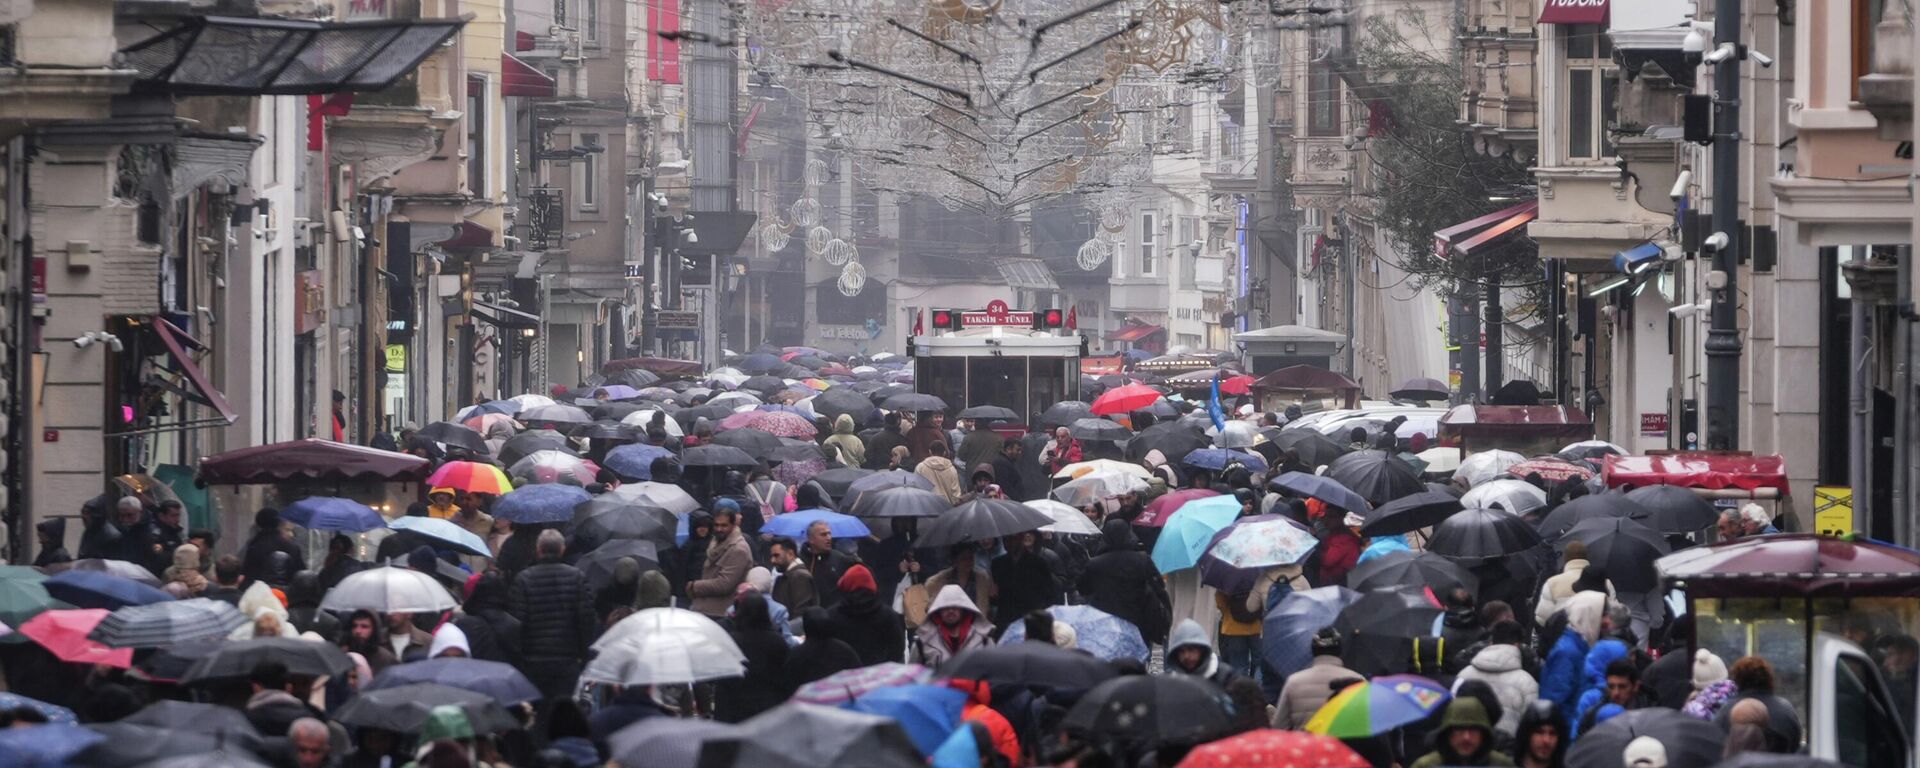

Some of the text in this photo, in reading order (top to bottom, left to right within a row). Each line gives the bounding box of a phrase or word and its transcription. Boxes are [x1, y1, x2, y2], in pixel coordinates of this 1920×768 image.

[992, 305, 1003, 313] 34
[966, 315, 996, 323] TAKSİM
[1005, 314, 1031, 323] TÜNEL
